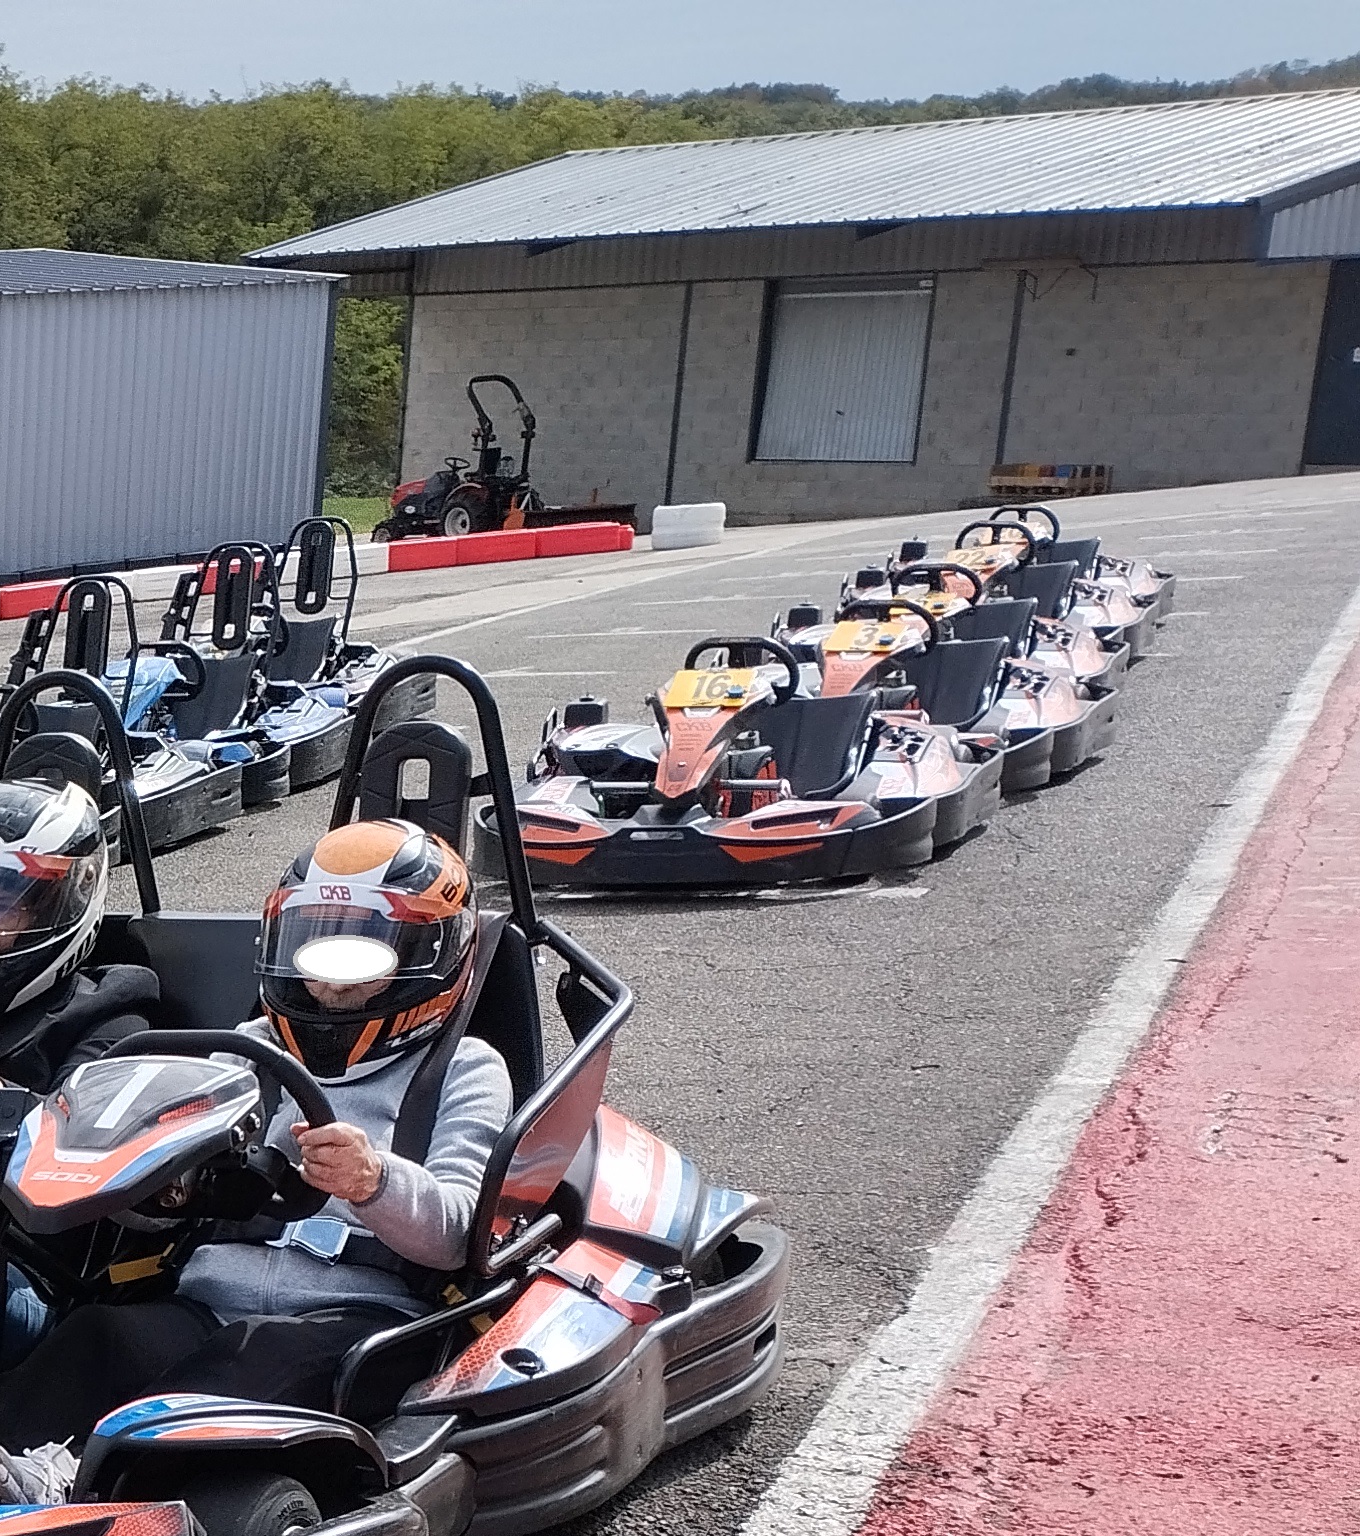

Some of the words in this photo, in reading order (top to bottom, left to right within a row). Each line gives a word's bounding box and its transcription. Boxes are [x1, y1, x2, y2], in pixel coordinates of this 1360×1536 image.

[854, 627, 879, 646] 3
[691, 674, 731, 700] 16
[319, 885, 352, 901] CKB
[93, 1063, 167, 1130] 1
[30, 1171, 101, 1185] SODI
